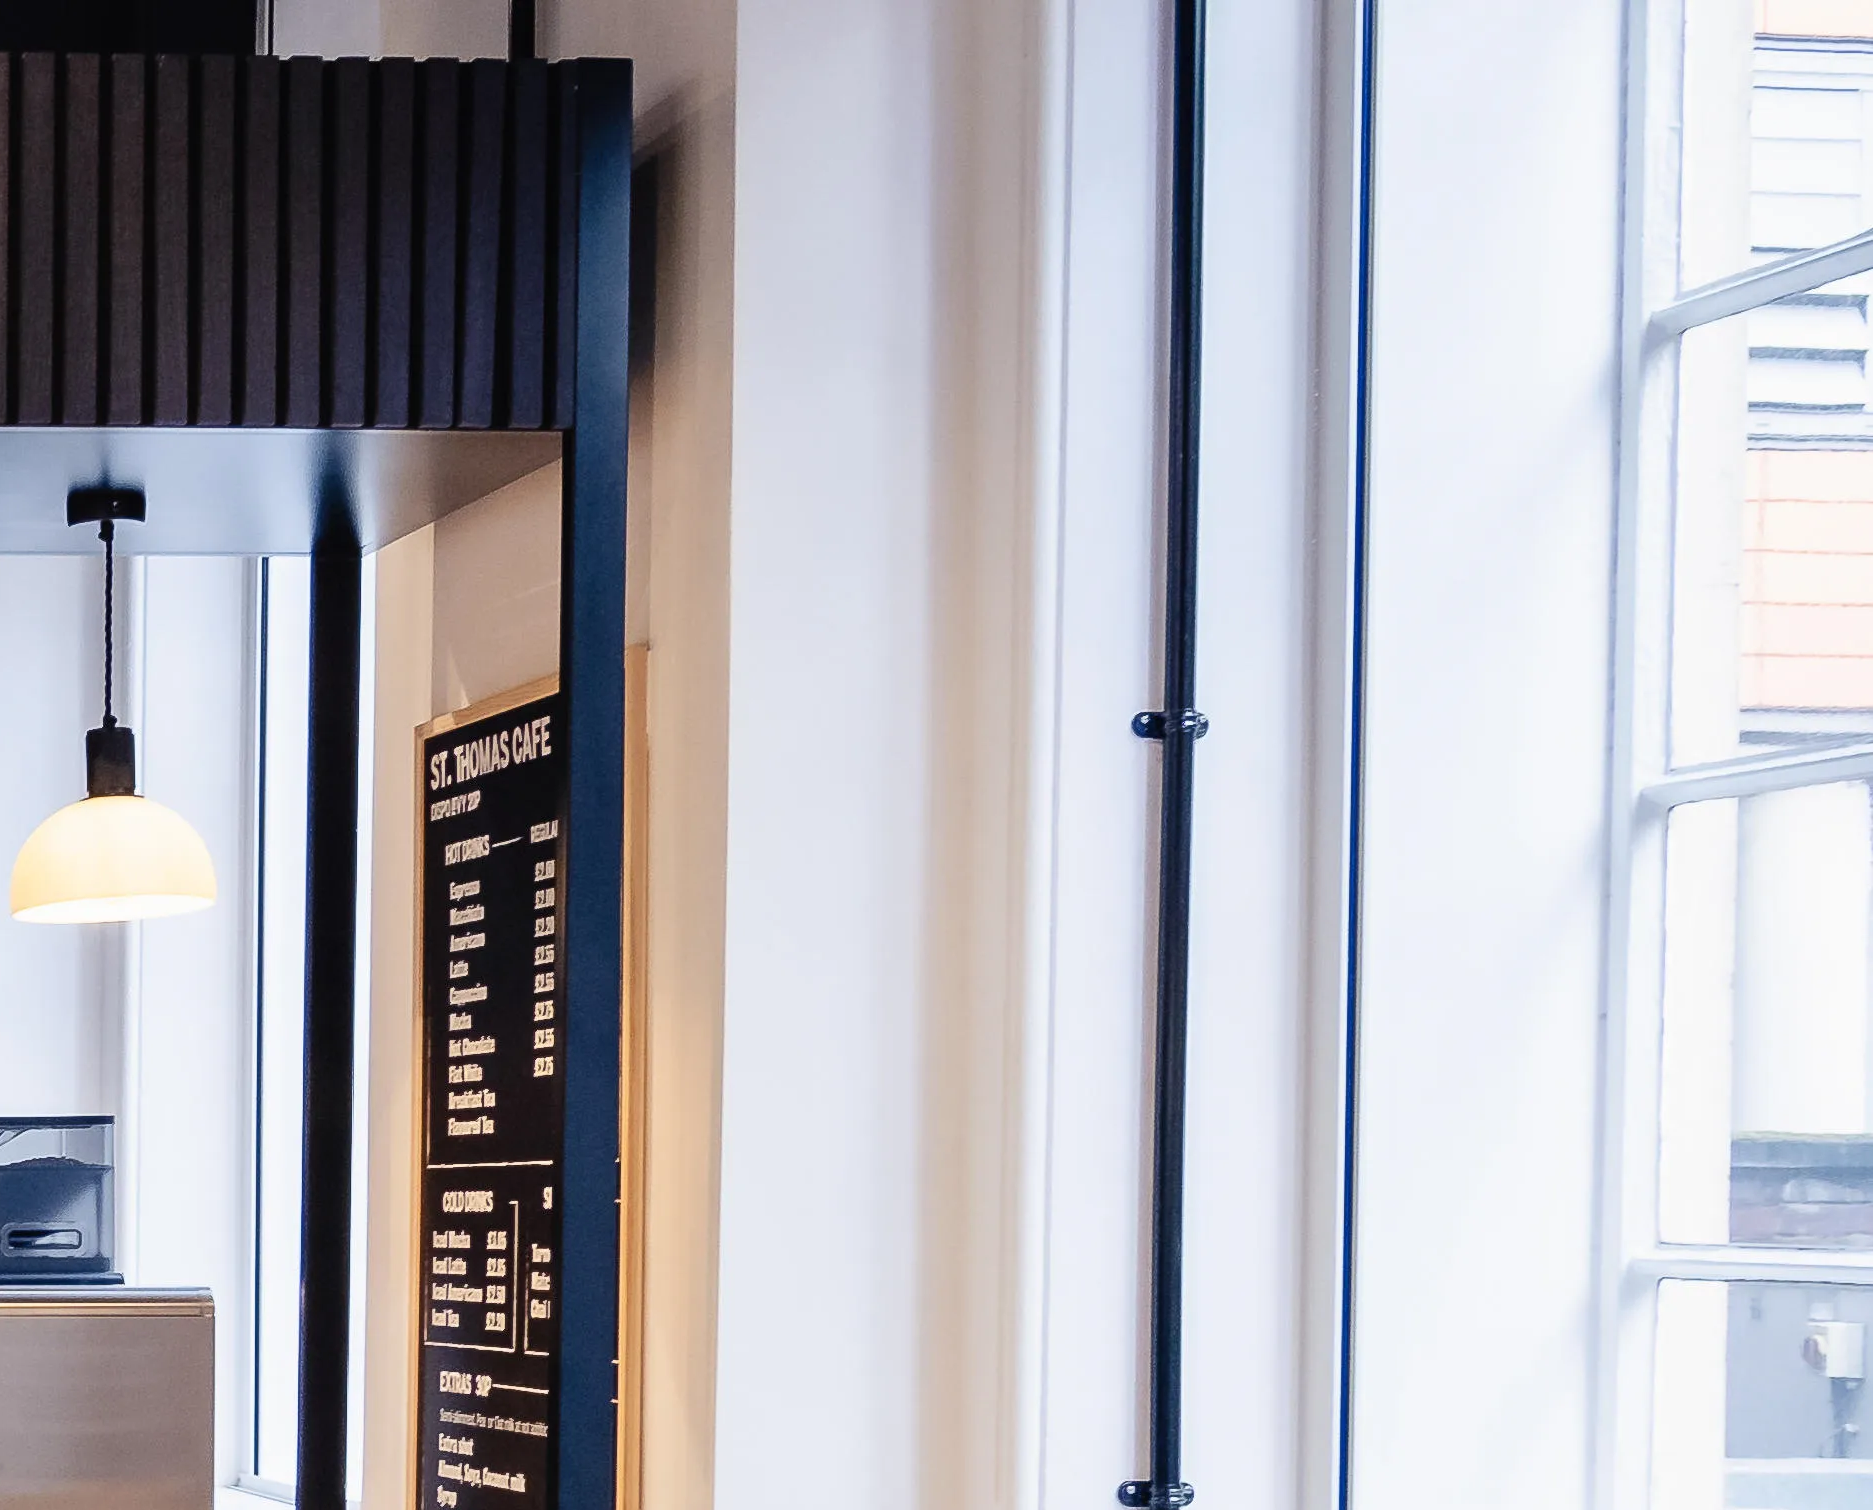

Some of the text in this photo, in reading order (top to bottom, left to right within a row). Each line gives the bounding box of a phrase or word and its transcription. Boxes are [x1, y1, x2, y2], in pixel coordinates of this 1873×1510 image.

[430, 715, 552, 791] ST. THOMAS CAFE
